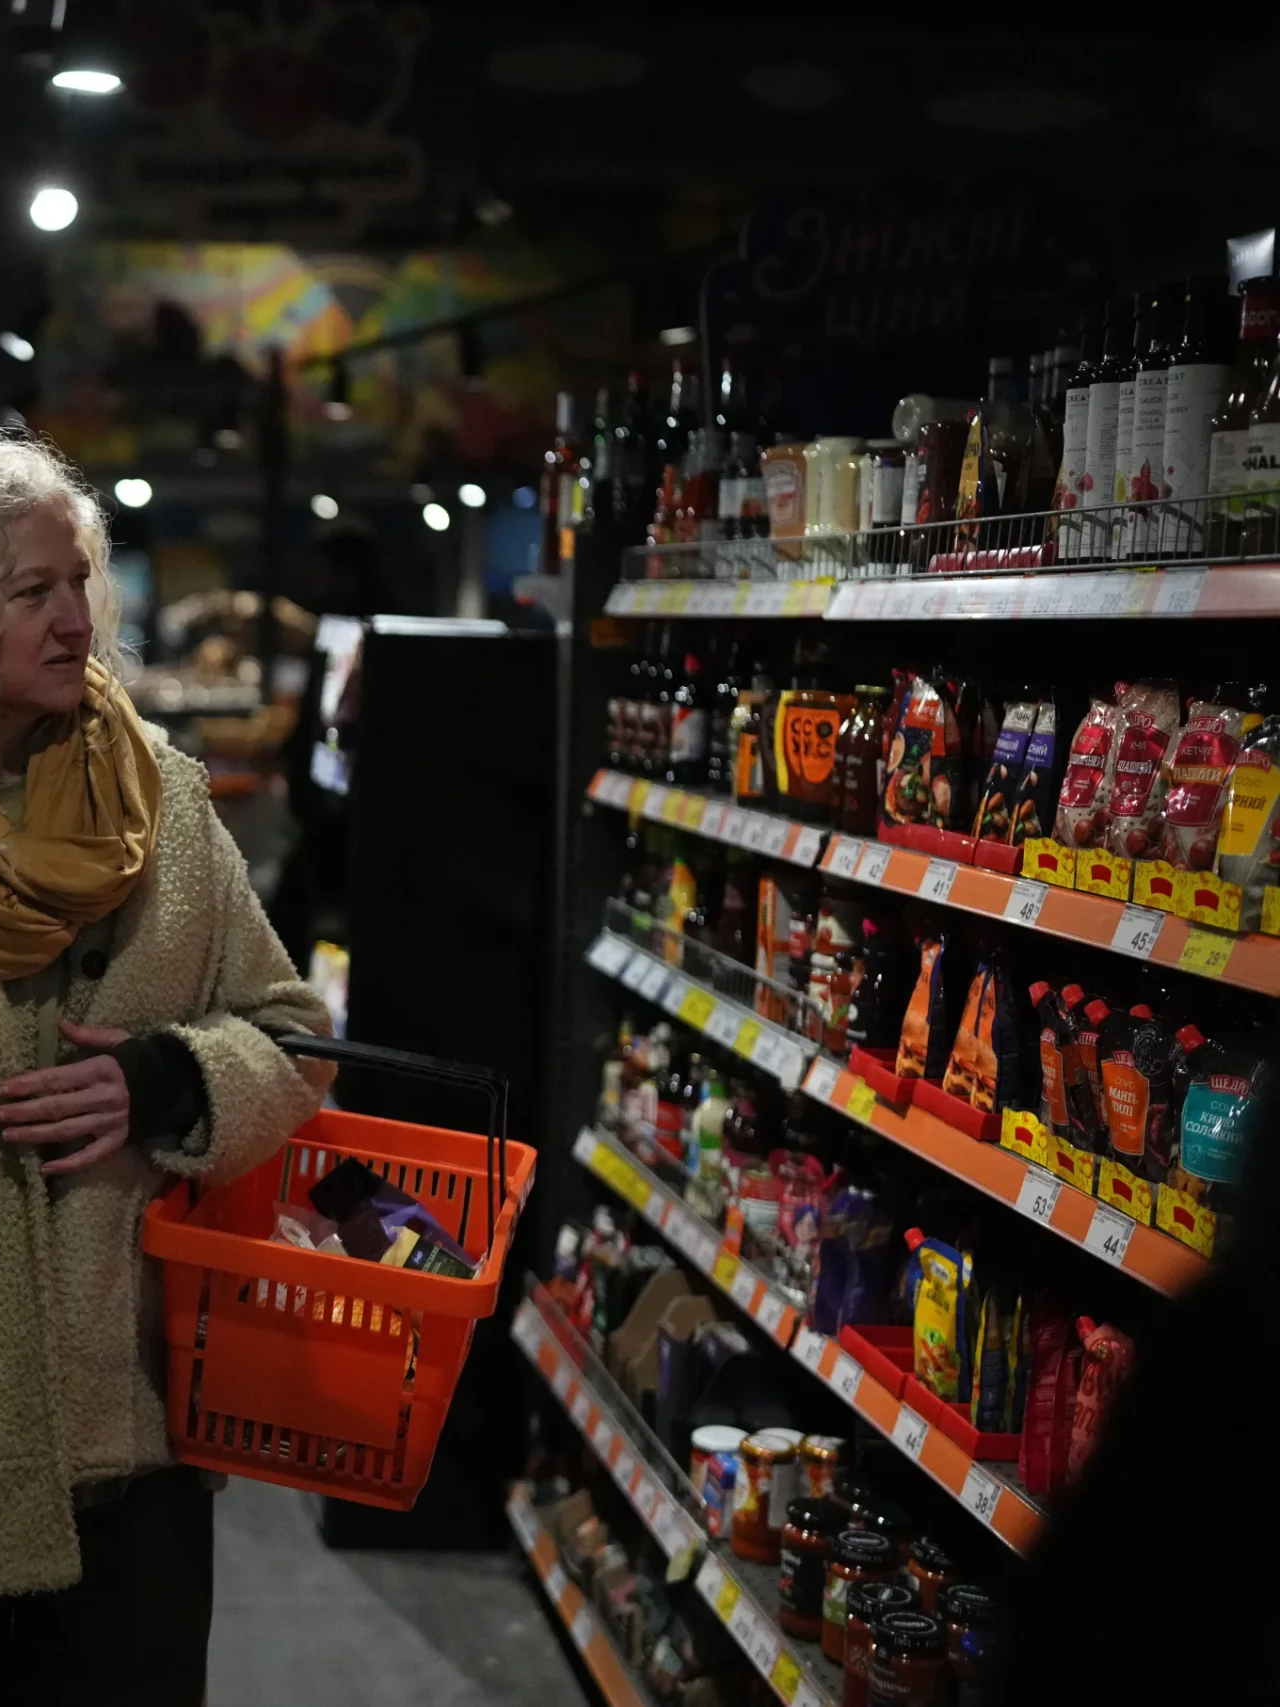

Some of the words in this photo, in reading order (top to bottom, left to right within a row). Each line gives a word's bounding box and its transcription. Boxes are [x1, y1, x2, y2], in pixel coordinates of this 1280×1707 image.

[1019, 901, 1034, 920] 48
[1131, 930, 1149, 951] 45
[1210, 1076, 1250, 1096] ЩЕДРО
[1032, 1195, 1046, 1216] 53
[1103, 1235, 1119, 1257] 44
[974, 1492, 988, 1514] 38
